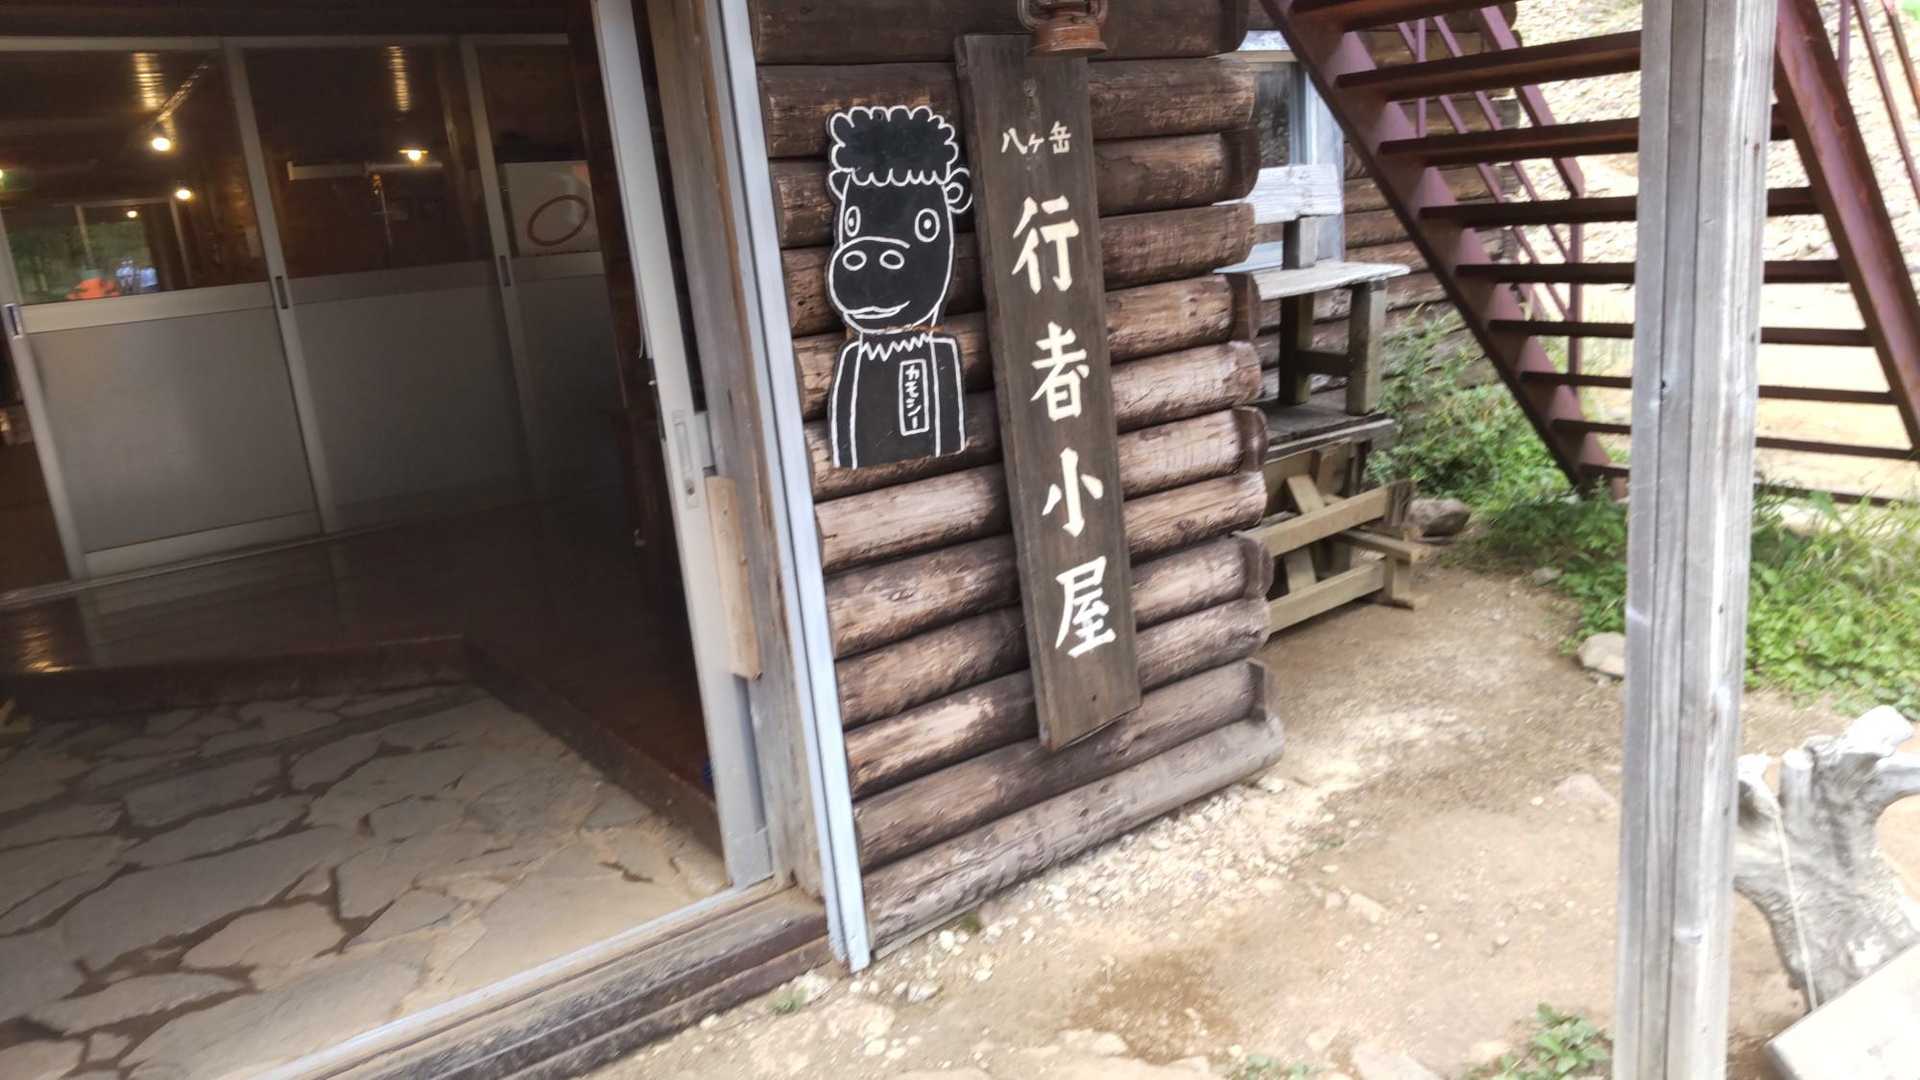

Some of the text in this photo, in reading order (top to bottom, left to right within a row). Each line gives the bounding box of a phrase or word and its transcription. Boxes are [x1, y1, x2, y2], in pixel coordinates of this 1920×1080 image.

[1001, 120, 1072, 155] 八ヶ岳
[904, 364, 922, 429] カモシー
[1011, 195, 1117, 658] 行者小屋
